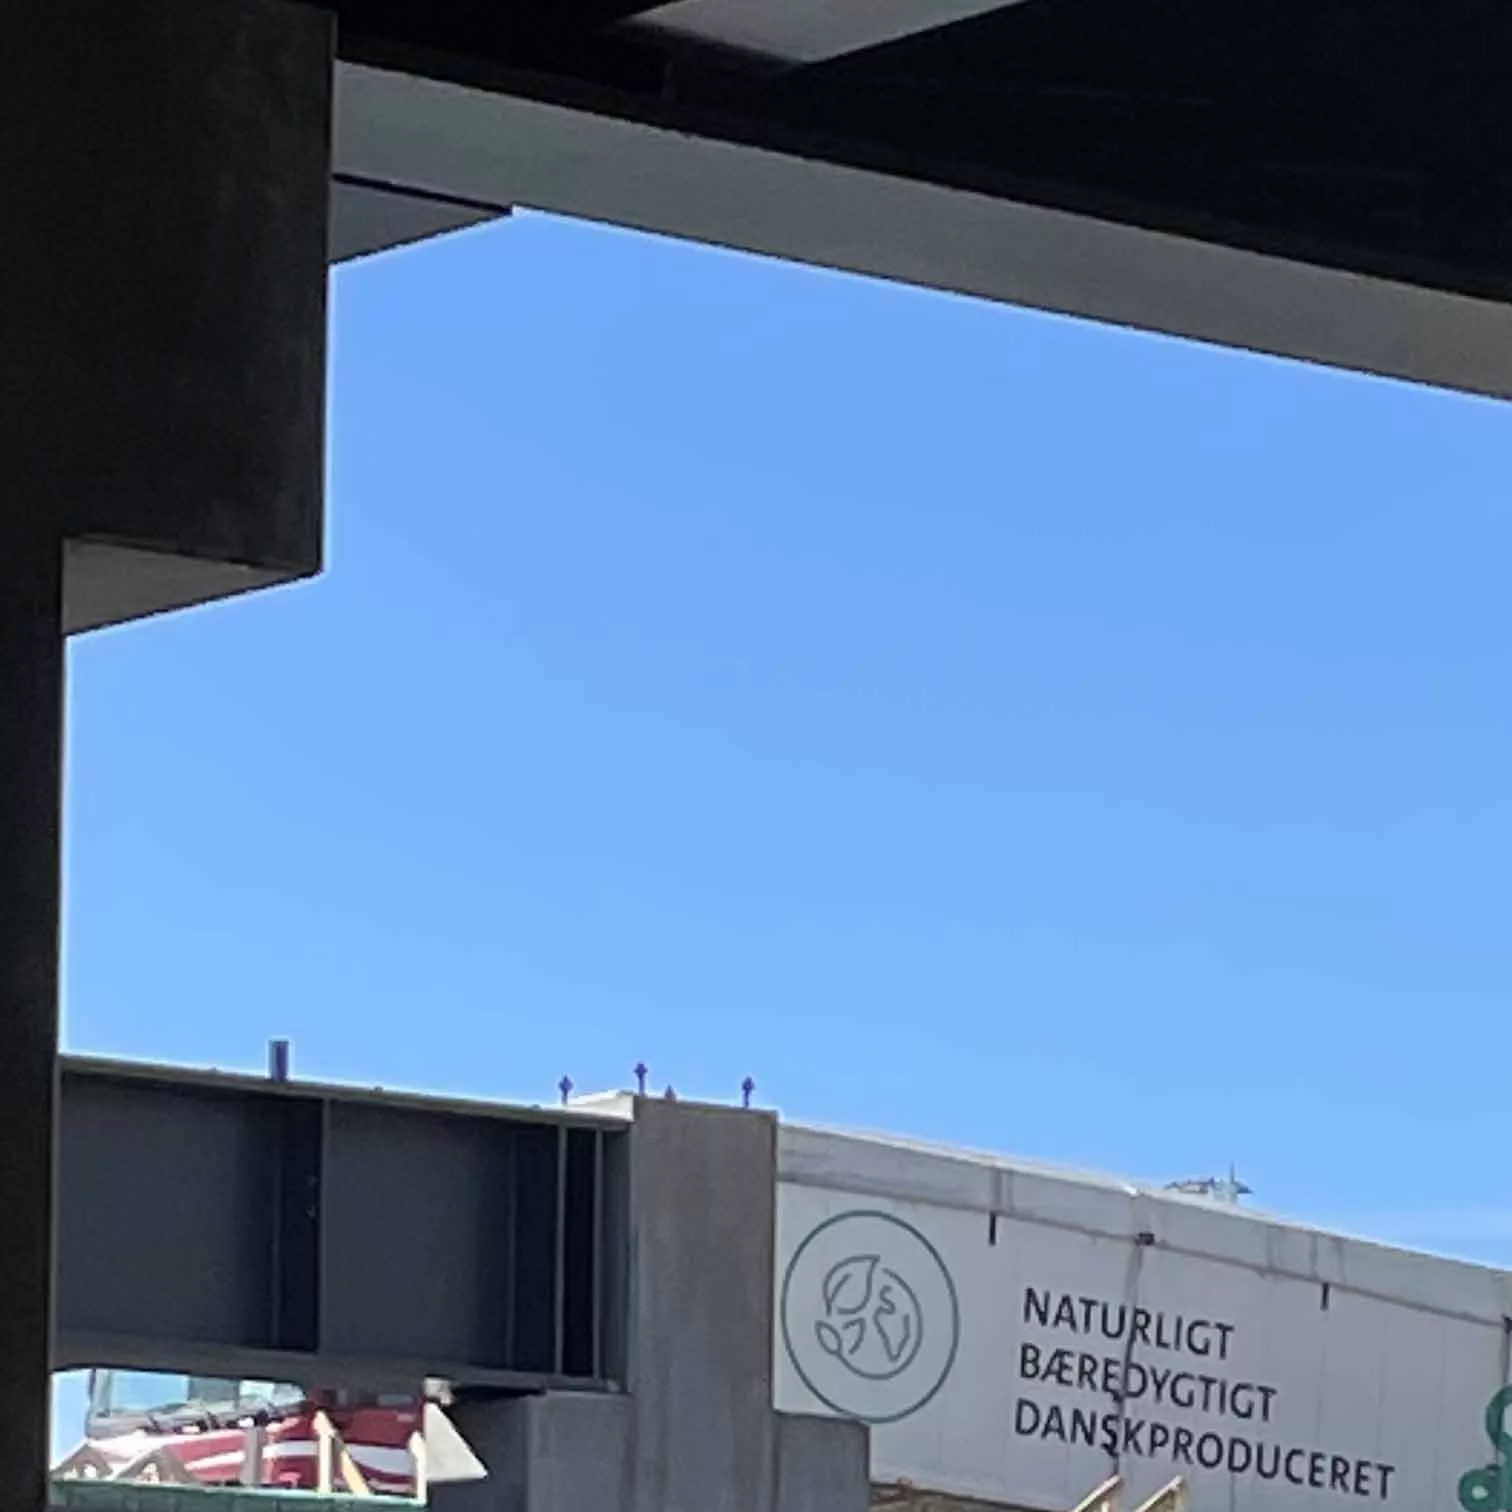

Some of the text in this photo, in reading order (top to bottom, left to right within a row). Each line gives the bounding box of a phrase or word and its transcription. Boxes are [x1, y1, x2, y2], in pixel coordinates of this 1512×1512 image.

[1023, 1286, 1235, 1361] NATURLIGT
[1020, 1342, 1277, 1422] BÆREDYGTIGT
[1014, 1398, 1394, 1500] DANSKPRODUCERET
